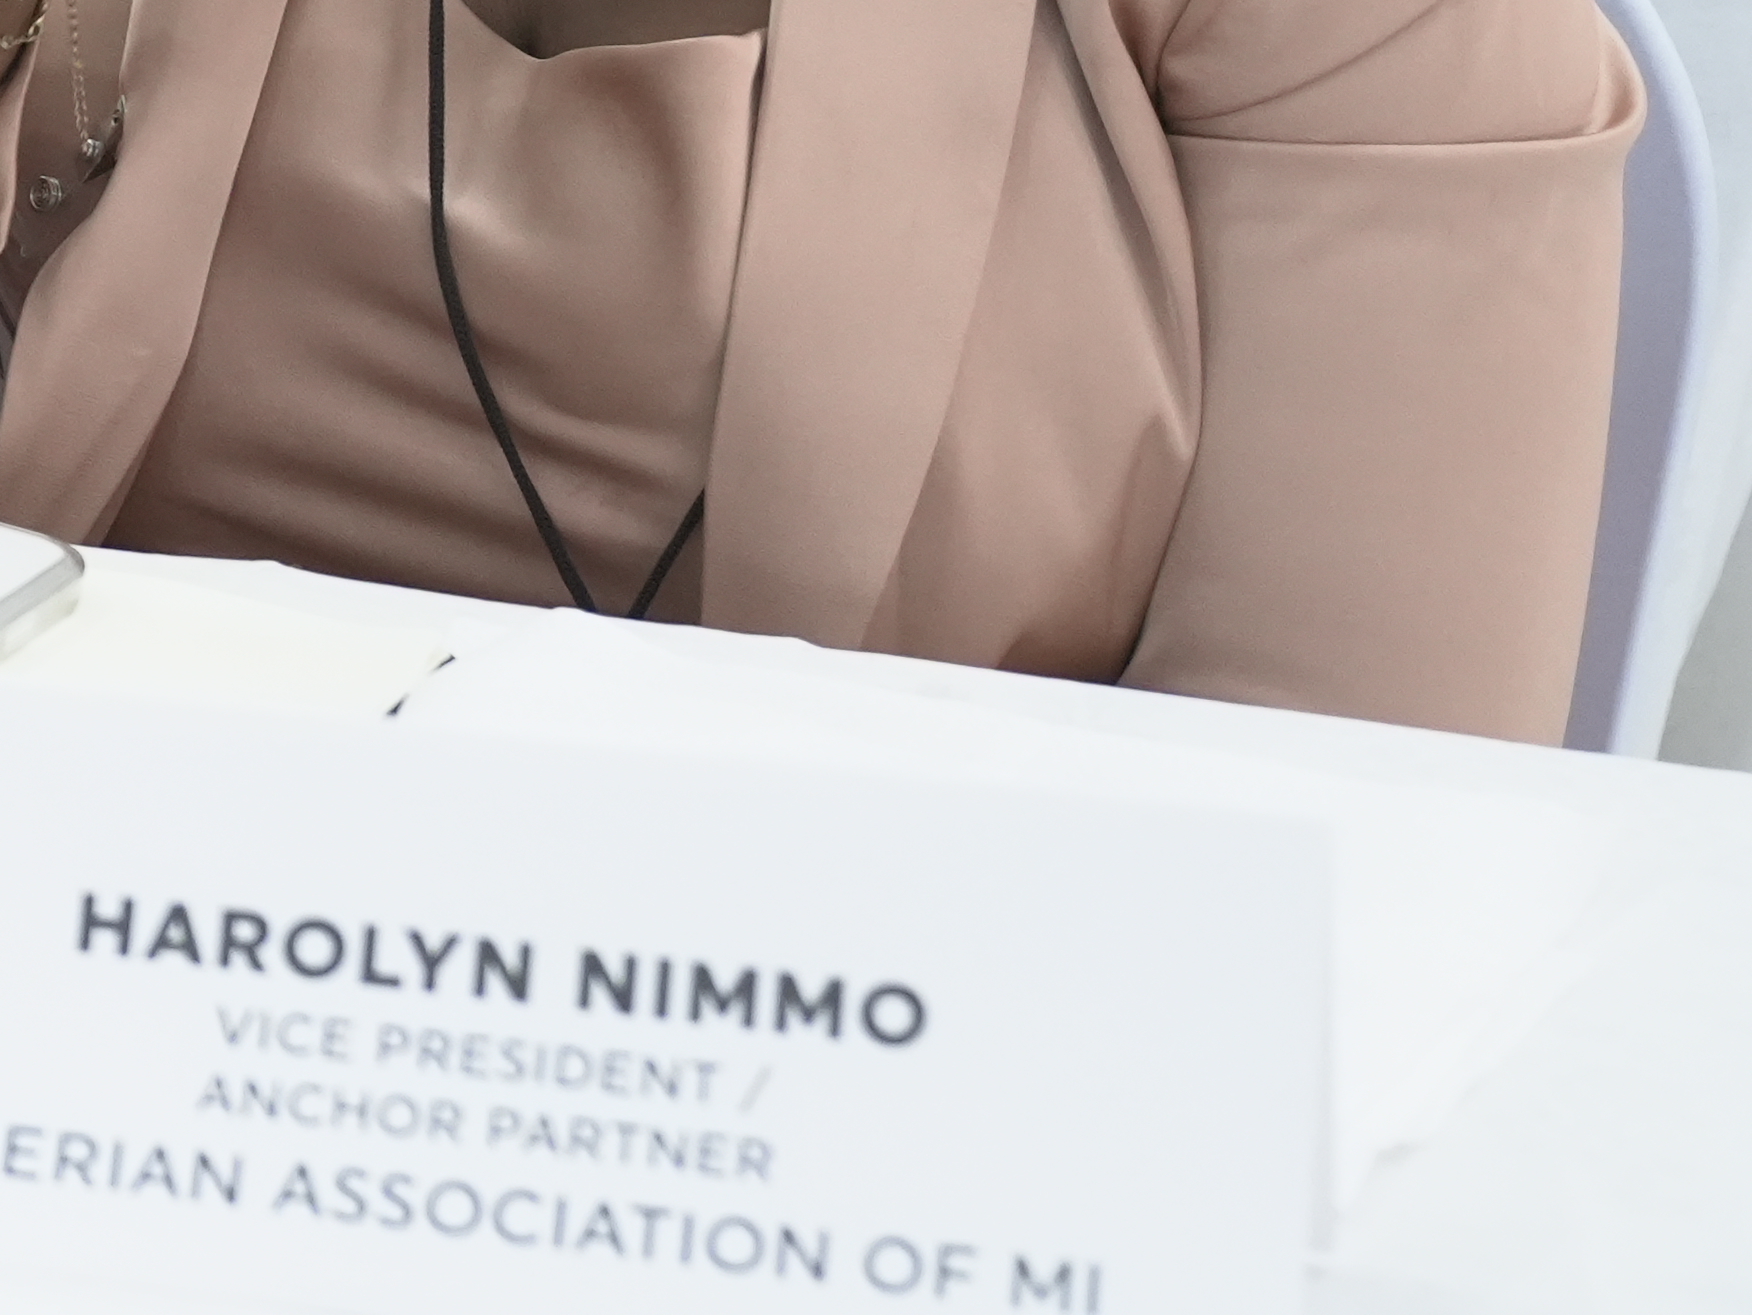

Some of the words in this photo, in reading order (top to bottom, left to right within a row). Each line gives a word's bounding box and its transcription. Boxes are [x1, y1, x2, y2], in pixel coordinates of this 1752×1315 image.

[73, 887, 538, 1008] HAROLYN
[573, 943, 933, 1053] NIMMO
[214, 1006, 351, 1063] VICE
[375, 1022, 722, 1105] PRESIDENT
[195, 1072, 466, 1144] ANCHOR
[486, 1104, 777, 1183] PARTNER
[271, 1159, 833, 1285] ASSOCIATION
[861, 1233, 979, 1300] OF
[1008, 1252, 1105, 1315] MI
